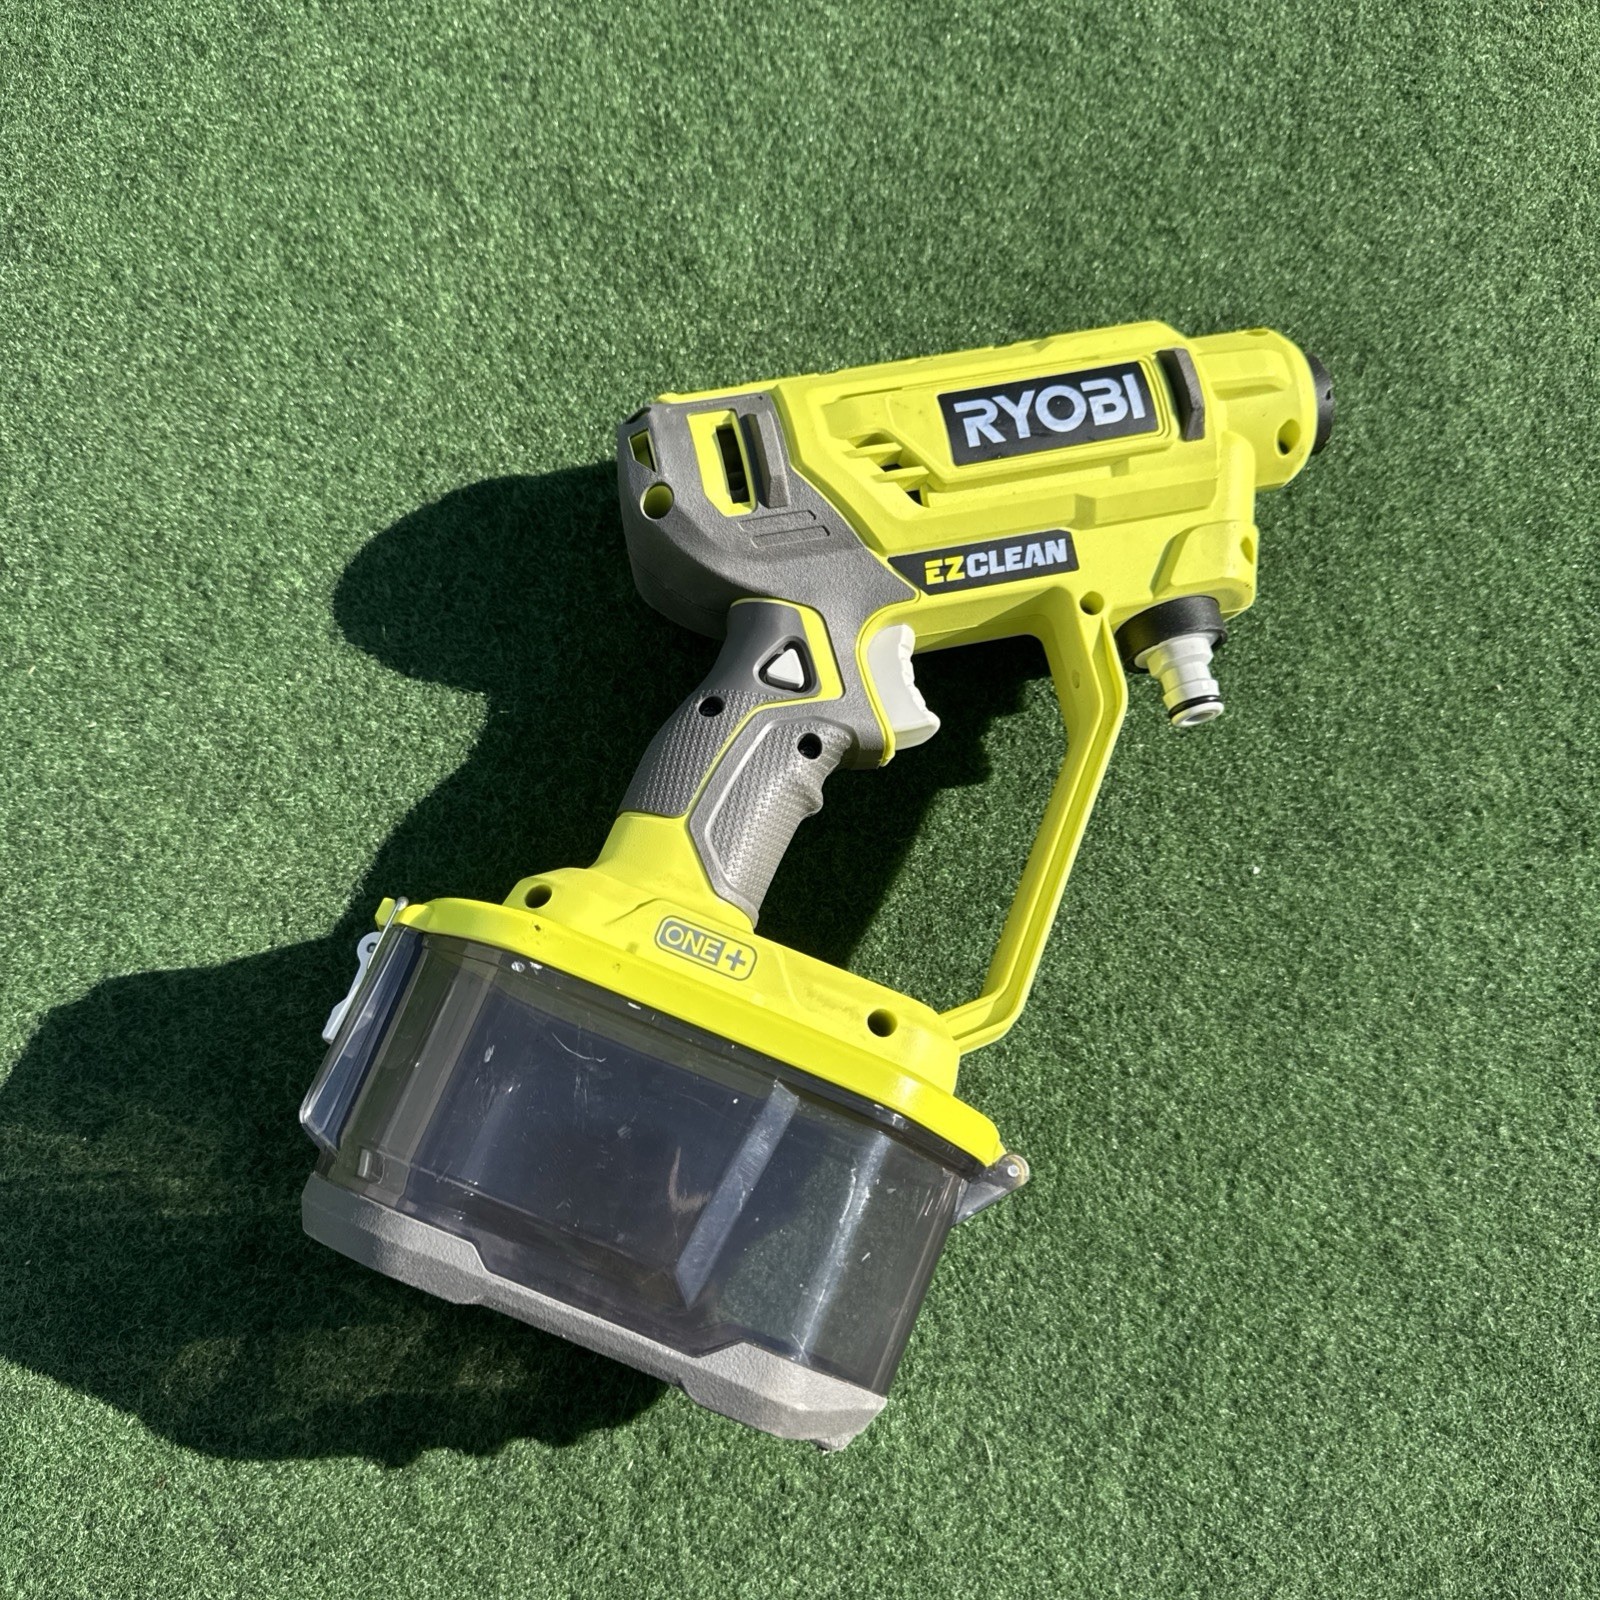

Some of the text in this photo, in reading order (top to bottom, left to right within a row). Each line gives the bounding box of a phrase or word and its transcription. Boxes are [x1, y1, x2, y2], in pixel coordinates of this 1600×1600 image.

[953, 373, 1146, 448] RYOBI
[924, 538, 1068, 586] EZCLEAN
[665, 925, 746, 972] ONE+
